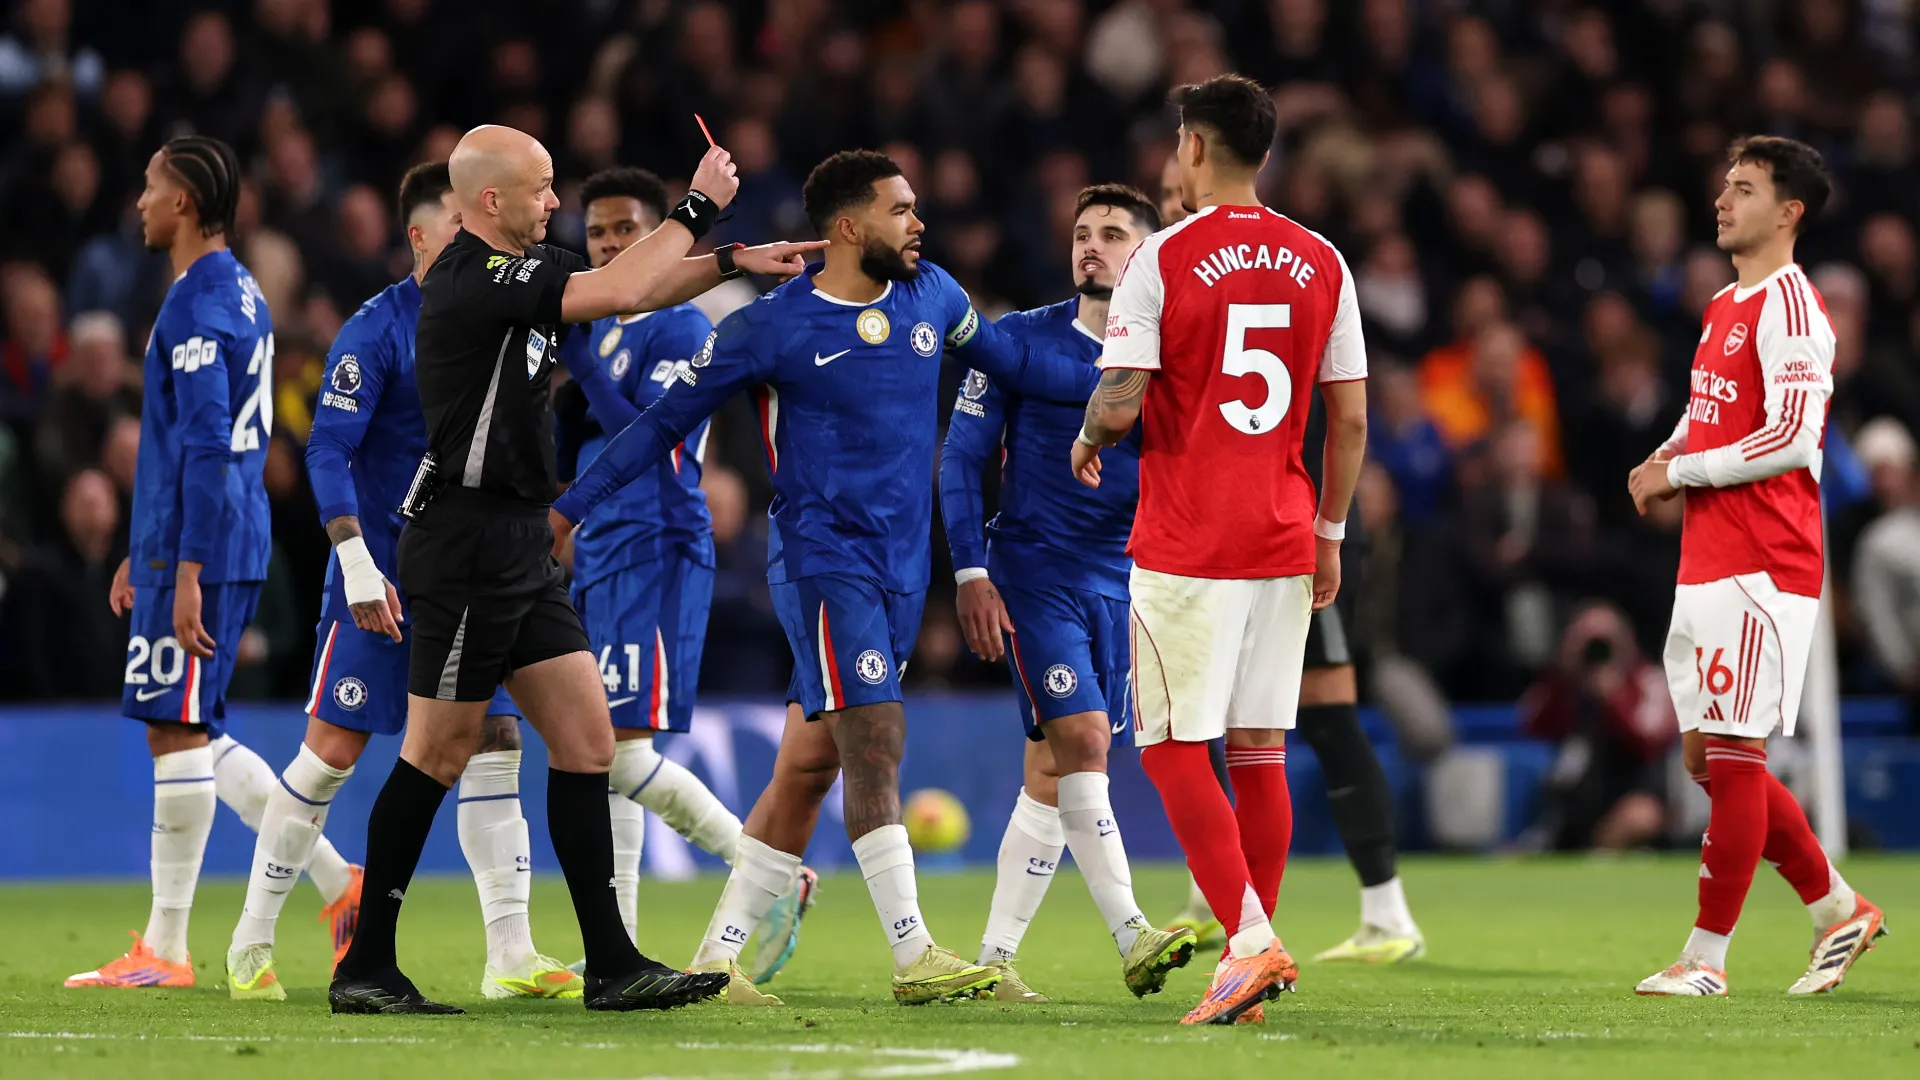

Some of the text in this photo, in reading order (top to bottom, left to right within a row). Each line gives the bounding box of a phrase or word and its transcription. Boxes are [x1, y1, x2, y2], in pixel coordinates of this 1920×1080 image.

[1228, 211, 1261, 220] Arsenal
[1193, 244, 1316, 289] HINCAPIE
[1106, 314, 1120, 327] SIT
[1105, 326, 1129, 338] NDA
[528, 333, 545, 354] FIFA
[1218, 304, 1293, 435] 5
[1784, 360, 1813, 373] VISIT
[1774, 372, 1824, 385] RWANDA
[331, 400, 358, 413] racism
[334, 394, 356, 406] room
[964, 400, 984, 411] room
[960, 406, 985, 418] racism
[125, 635, 185, 685] 20
[598, 643, 640, 693] 41
[267, 862, 294, 875] CFC
[1029, 857, 1055, 870] CFC
[894, 915, 917, 930] CFC
[725, 925, 747, 941] CFC
